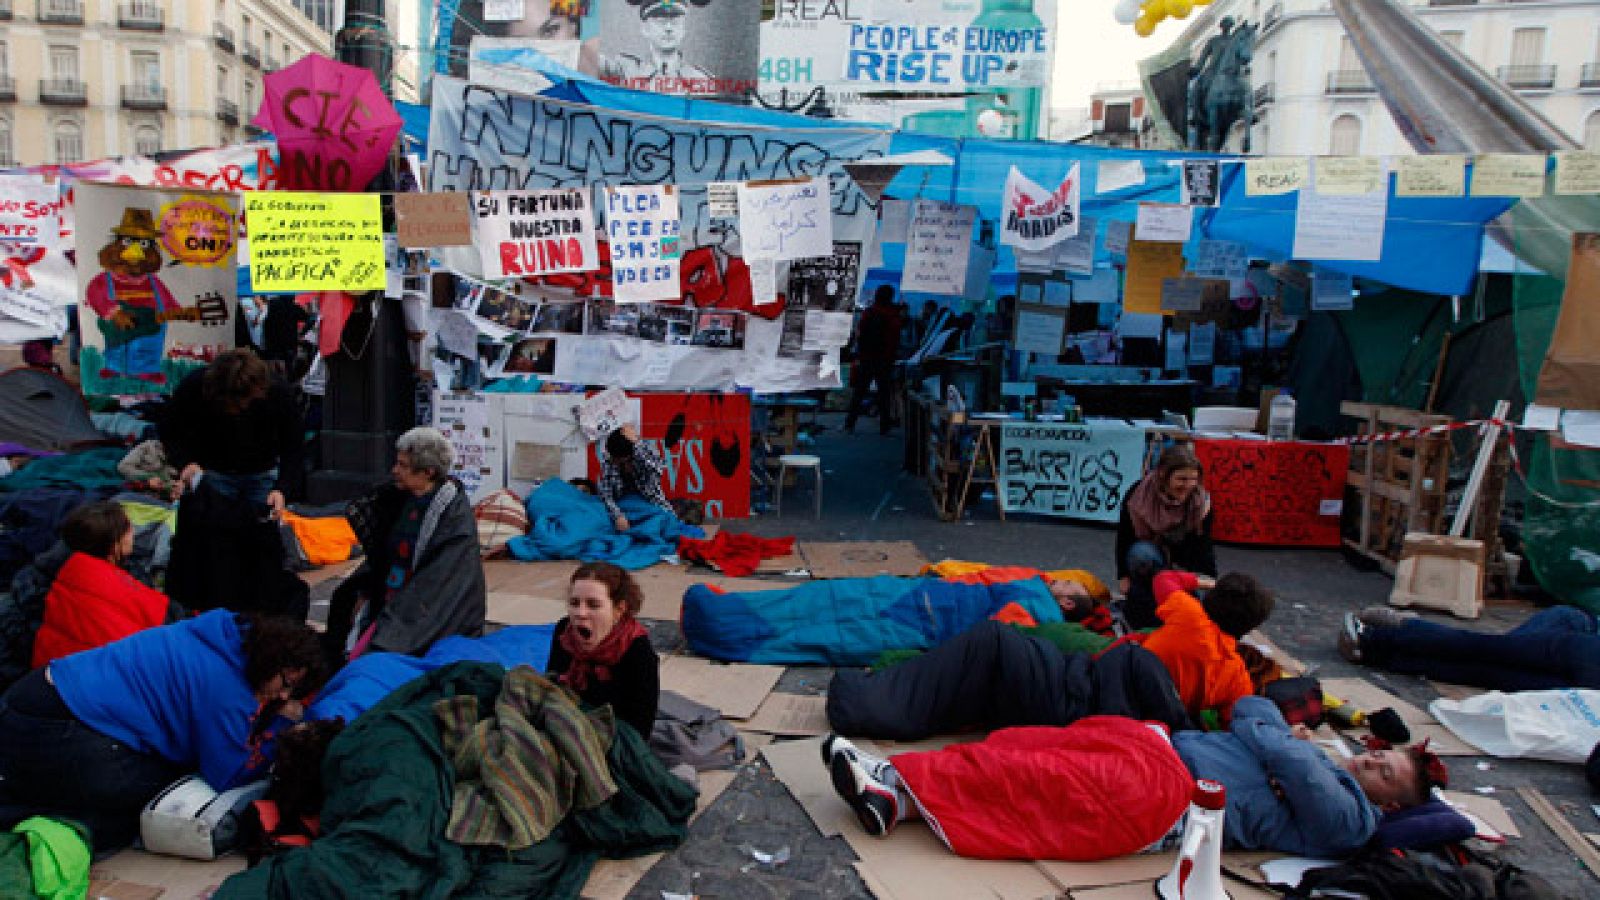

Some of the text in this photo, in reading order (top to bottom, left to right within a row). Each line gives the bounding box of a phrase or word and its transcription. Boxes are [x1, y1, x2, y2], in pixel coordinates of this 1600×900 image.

[850, 24, 940, 50] PEOPLE
[964, 27, 1047, 53] EUROPE
[758, 57, 813, 83] 48H
[961, 54, 1004, 85] UP
[477, 193, 584, 216] SU FORTUNA
[510, 219, 582, 239] NUESTRA
[500, 237, 583, 276] RUINA
[1005, 447, 1124, 490] BARRIOS
